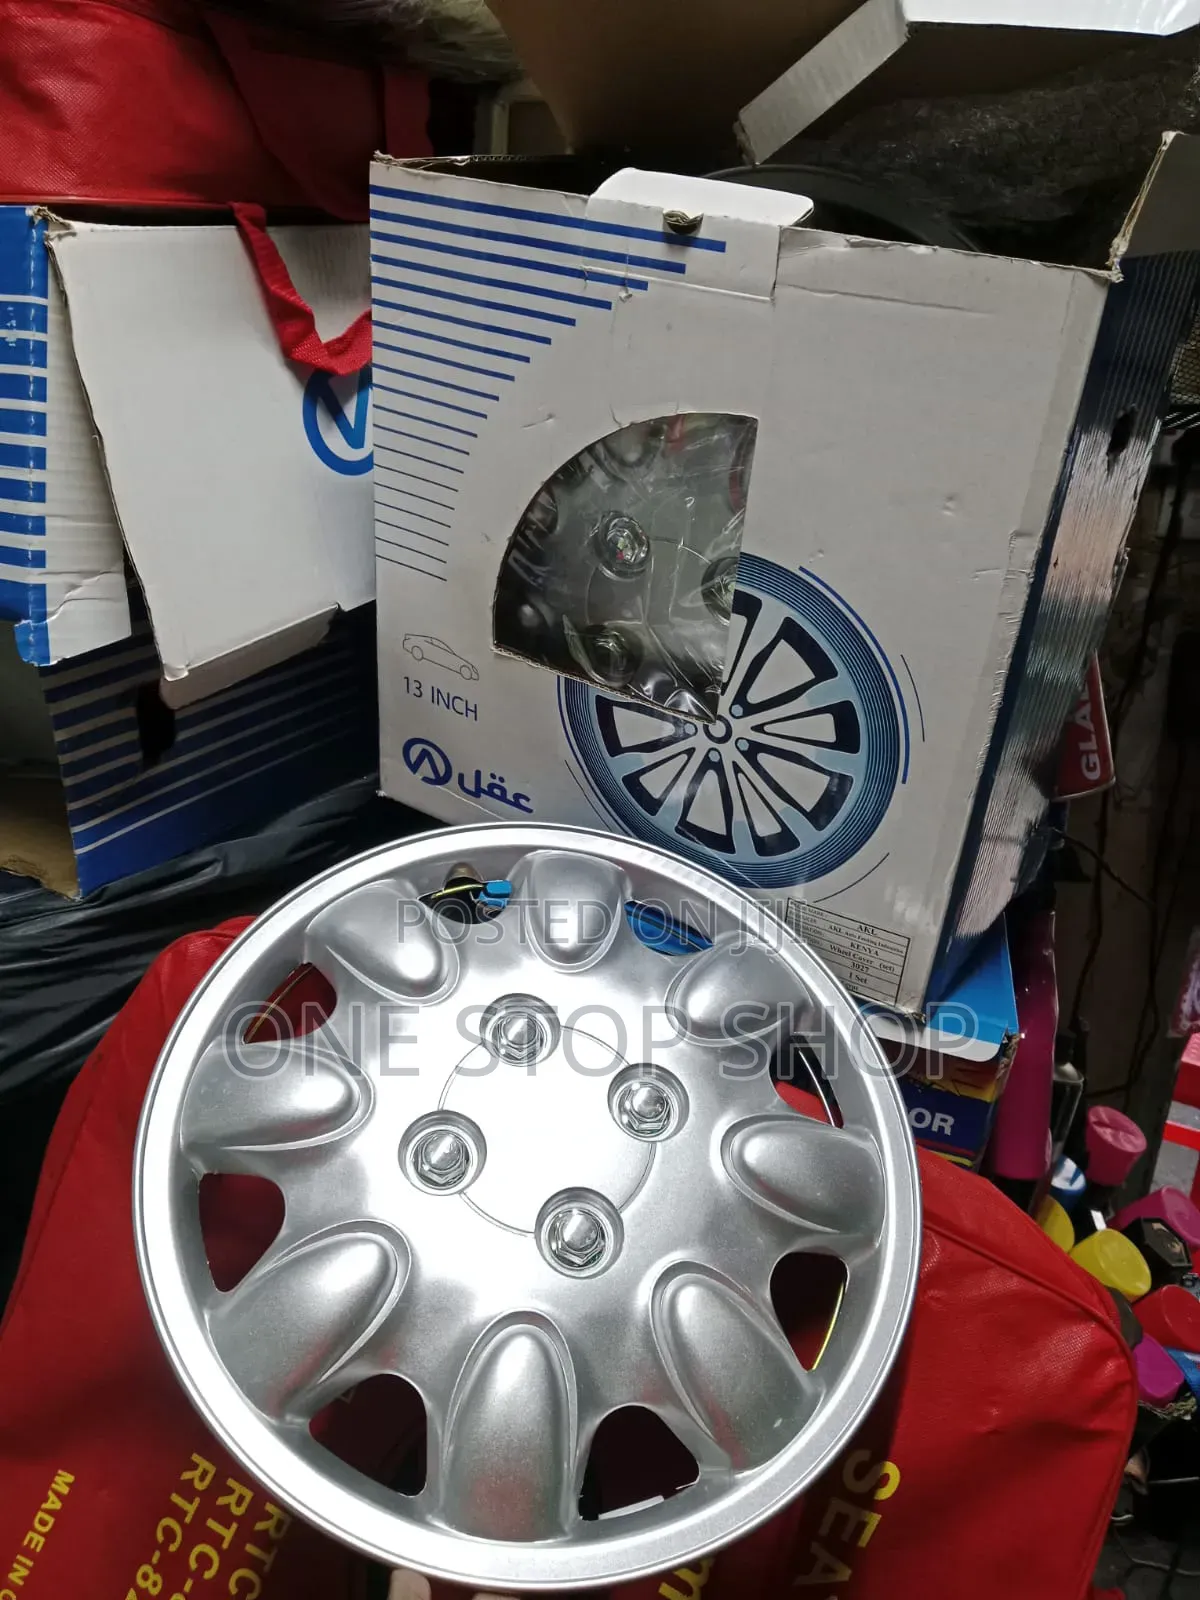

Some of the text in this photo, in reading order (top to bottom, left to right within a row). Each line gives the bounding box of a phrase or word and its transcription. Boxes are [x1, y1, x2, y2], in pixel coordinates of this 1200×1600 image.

[403, 676, 478, 721] 13 INCH
[458, 769, 533, 814] عقل
[850, 942, 879, 957] KENYA
[856, 924, 878, 937] AKL
[829, 944, 852, 957] Wheel
[852, 953, 874, 965] Cover
[23, 1469, 76, 1552] MADE
[795, 1449, 901, 1600] SEA
[7, 1554, 34, 1586] IN
